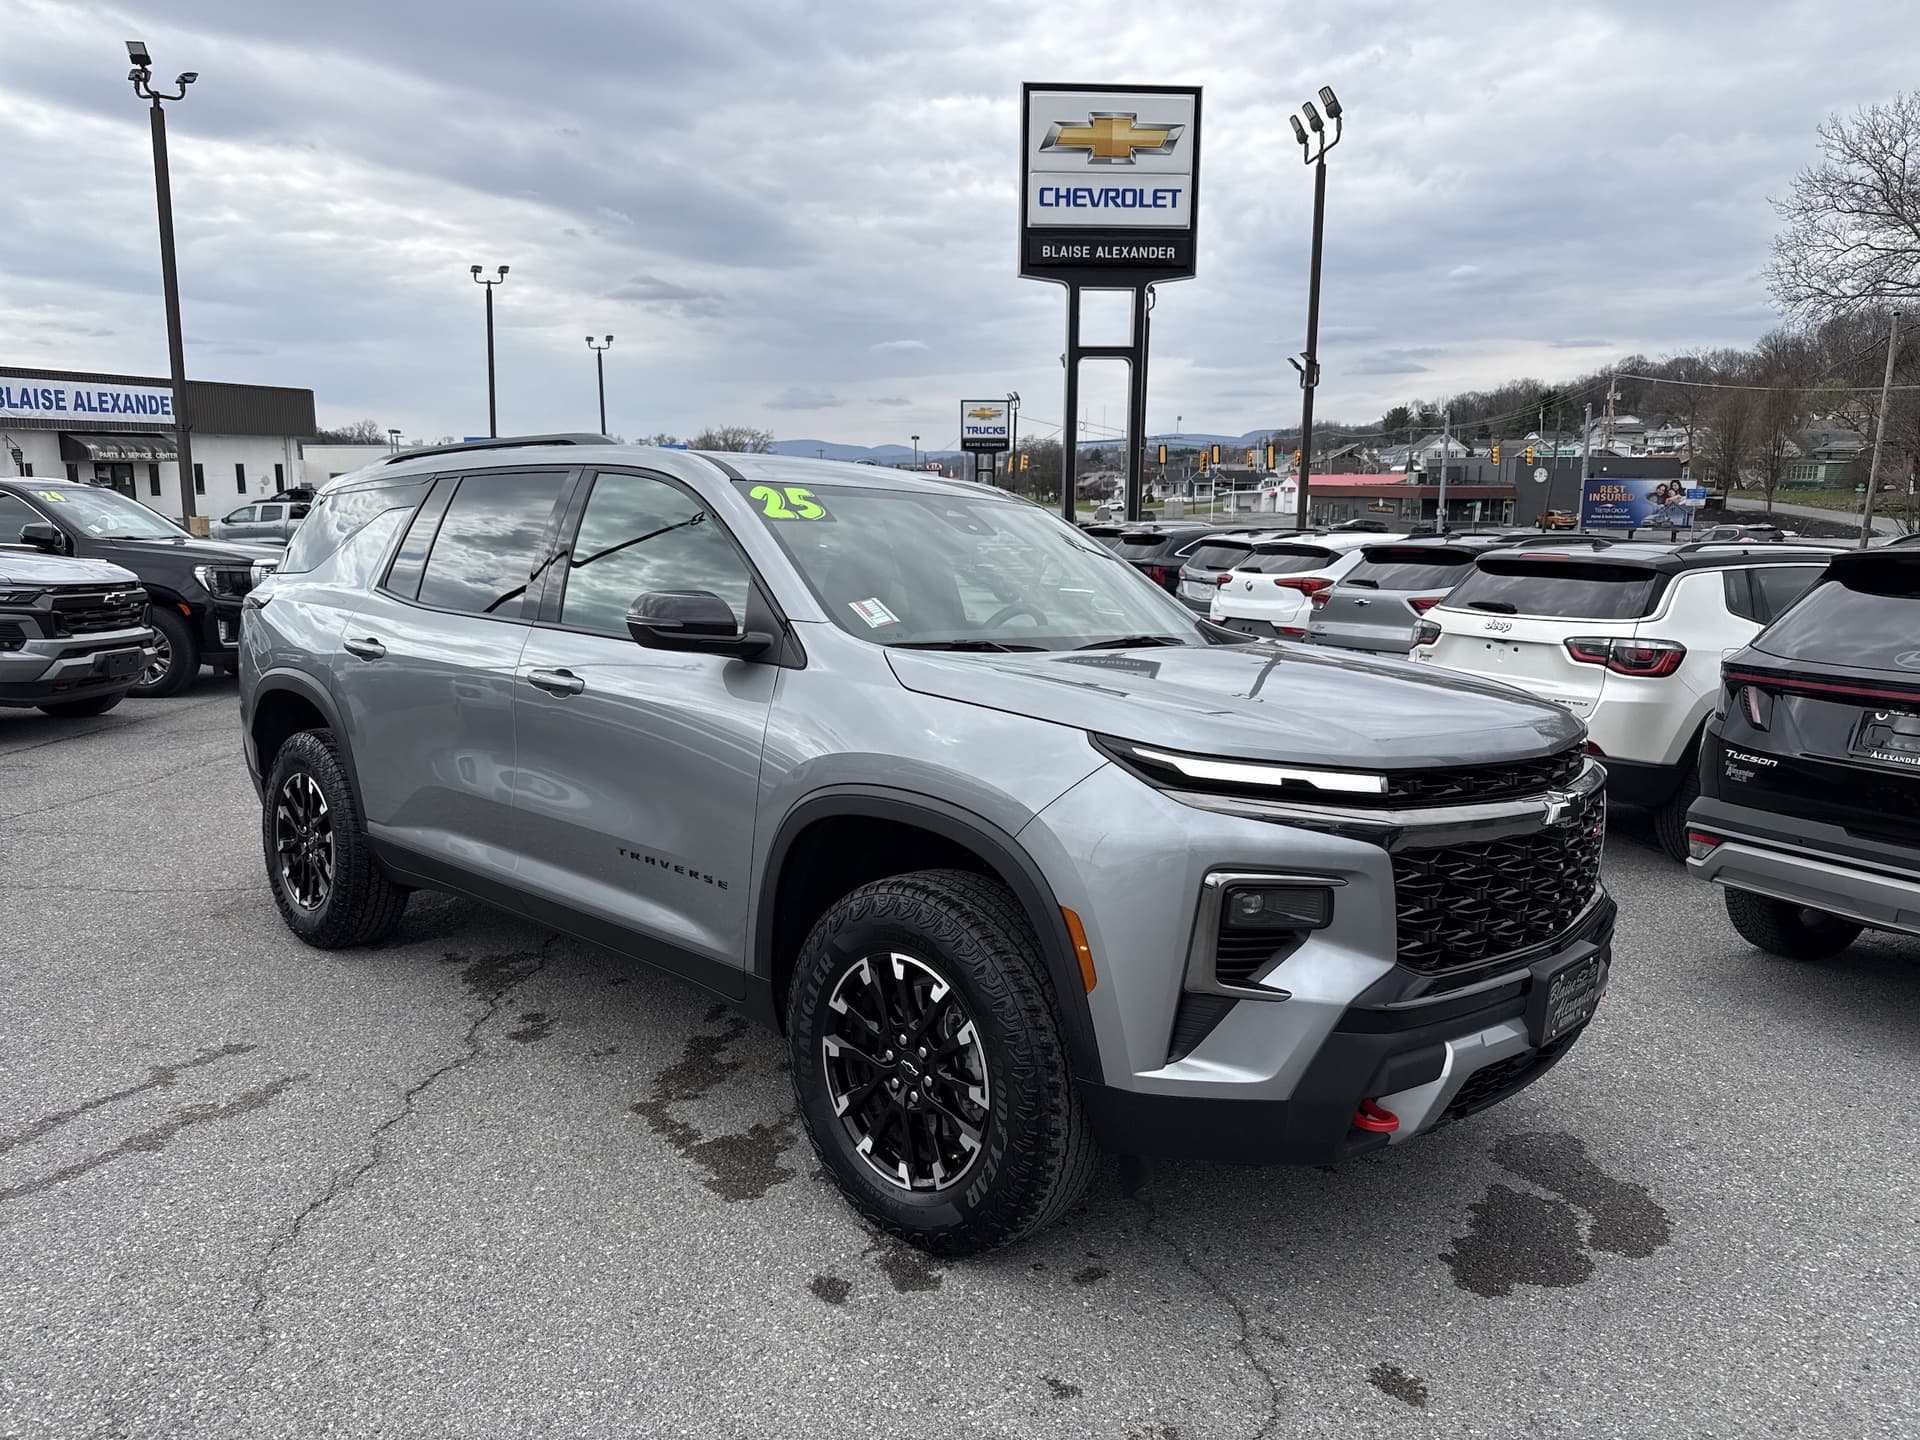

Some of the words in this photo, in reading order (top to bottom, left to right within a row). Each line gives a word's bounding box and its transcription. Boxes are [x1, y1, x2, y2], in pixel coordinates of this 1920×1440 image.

[1039, 187, 1182, 208] CHEVROLET
[1042, 245, 1090, 258] BLAISE
[1096, 246, 1175, 259] ALEXANDER
[73, 390, 176, 416] ALEXANDE
[965, 426, 1006, 435] TRUCKS
[1600, 485, 1627, 493] REST
[750, 485, 827, 520] 25
[1589, 493, 1635, 502] INSURED
[1485, 619, 1512, 633] Jeep
[617, 847, 728, 890] TRAVERSE
